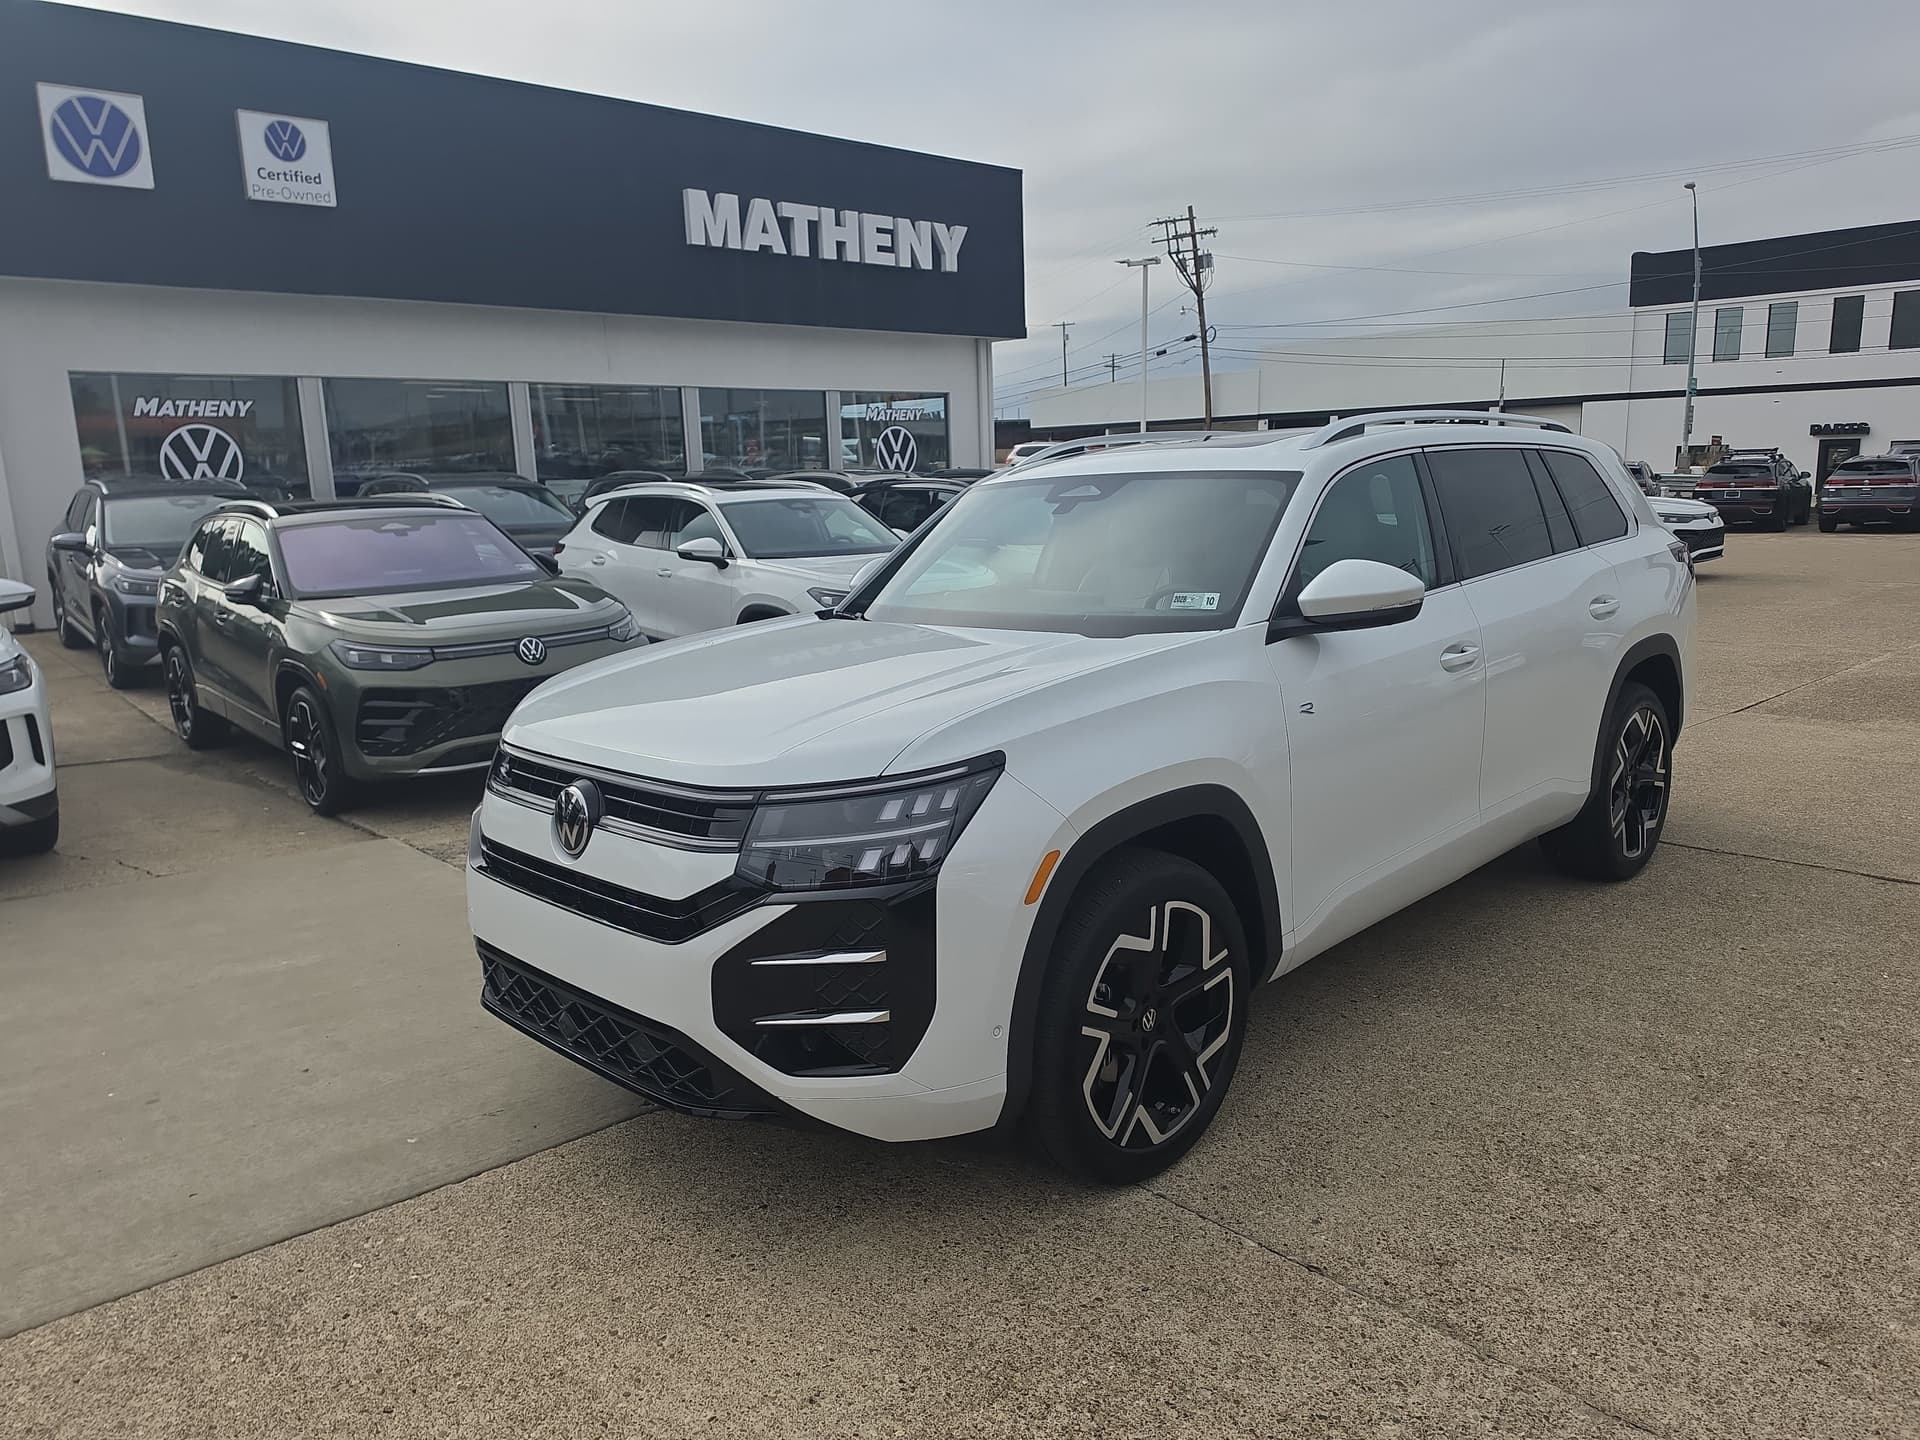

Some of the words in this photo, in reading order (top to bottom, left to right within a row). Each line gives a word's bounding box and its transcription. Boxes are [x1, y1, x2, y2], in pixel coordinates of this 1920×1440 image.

[257, 167, 322, 185] Certified
[251, 183, 332, 204] Pre-Owned
[682, 188, 968, 273] MATHENY
[133, 397, 254, 418] MATHENY
[865, 406, 924, 421] MATHENY
[1206, 596, 1215, 606] 10
